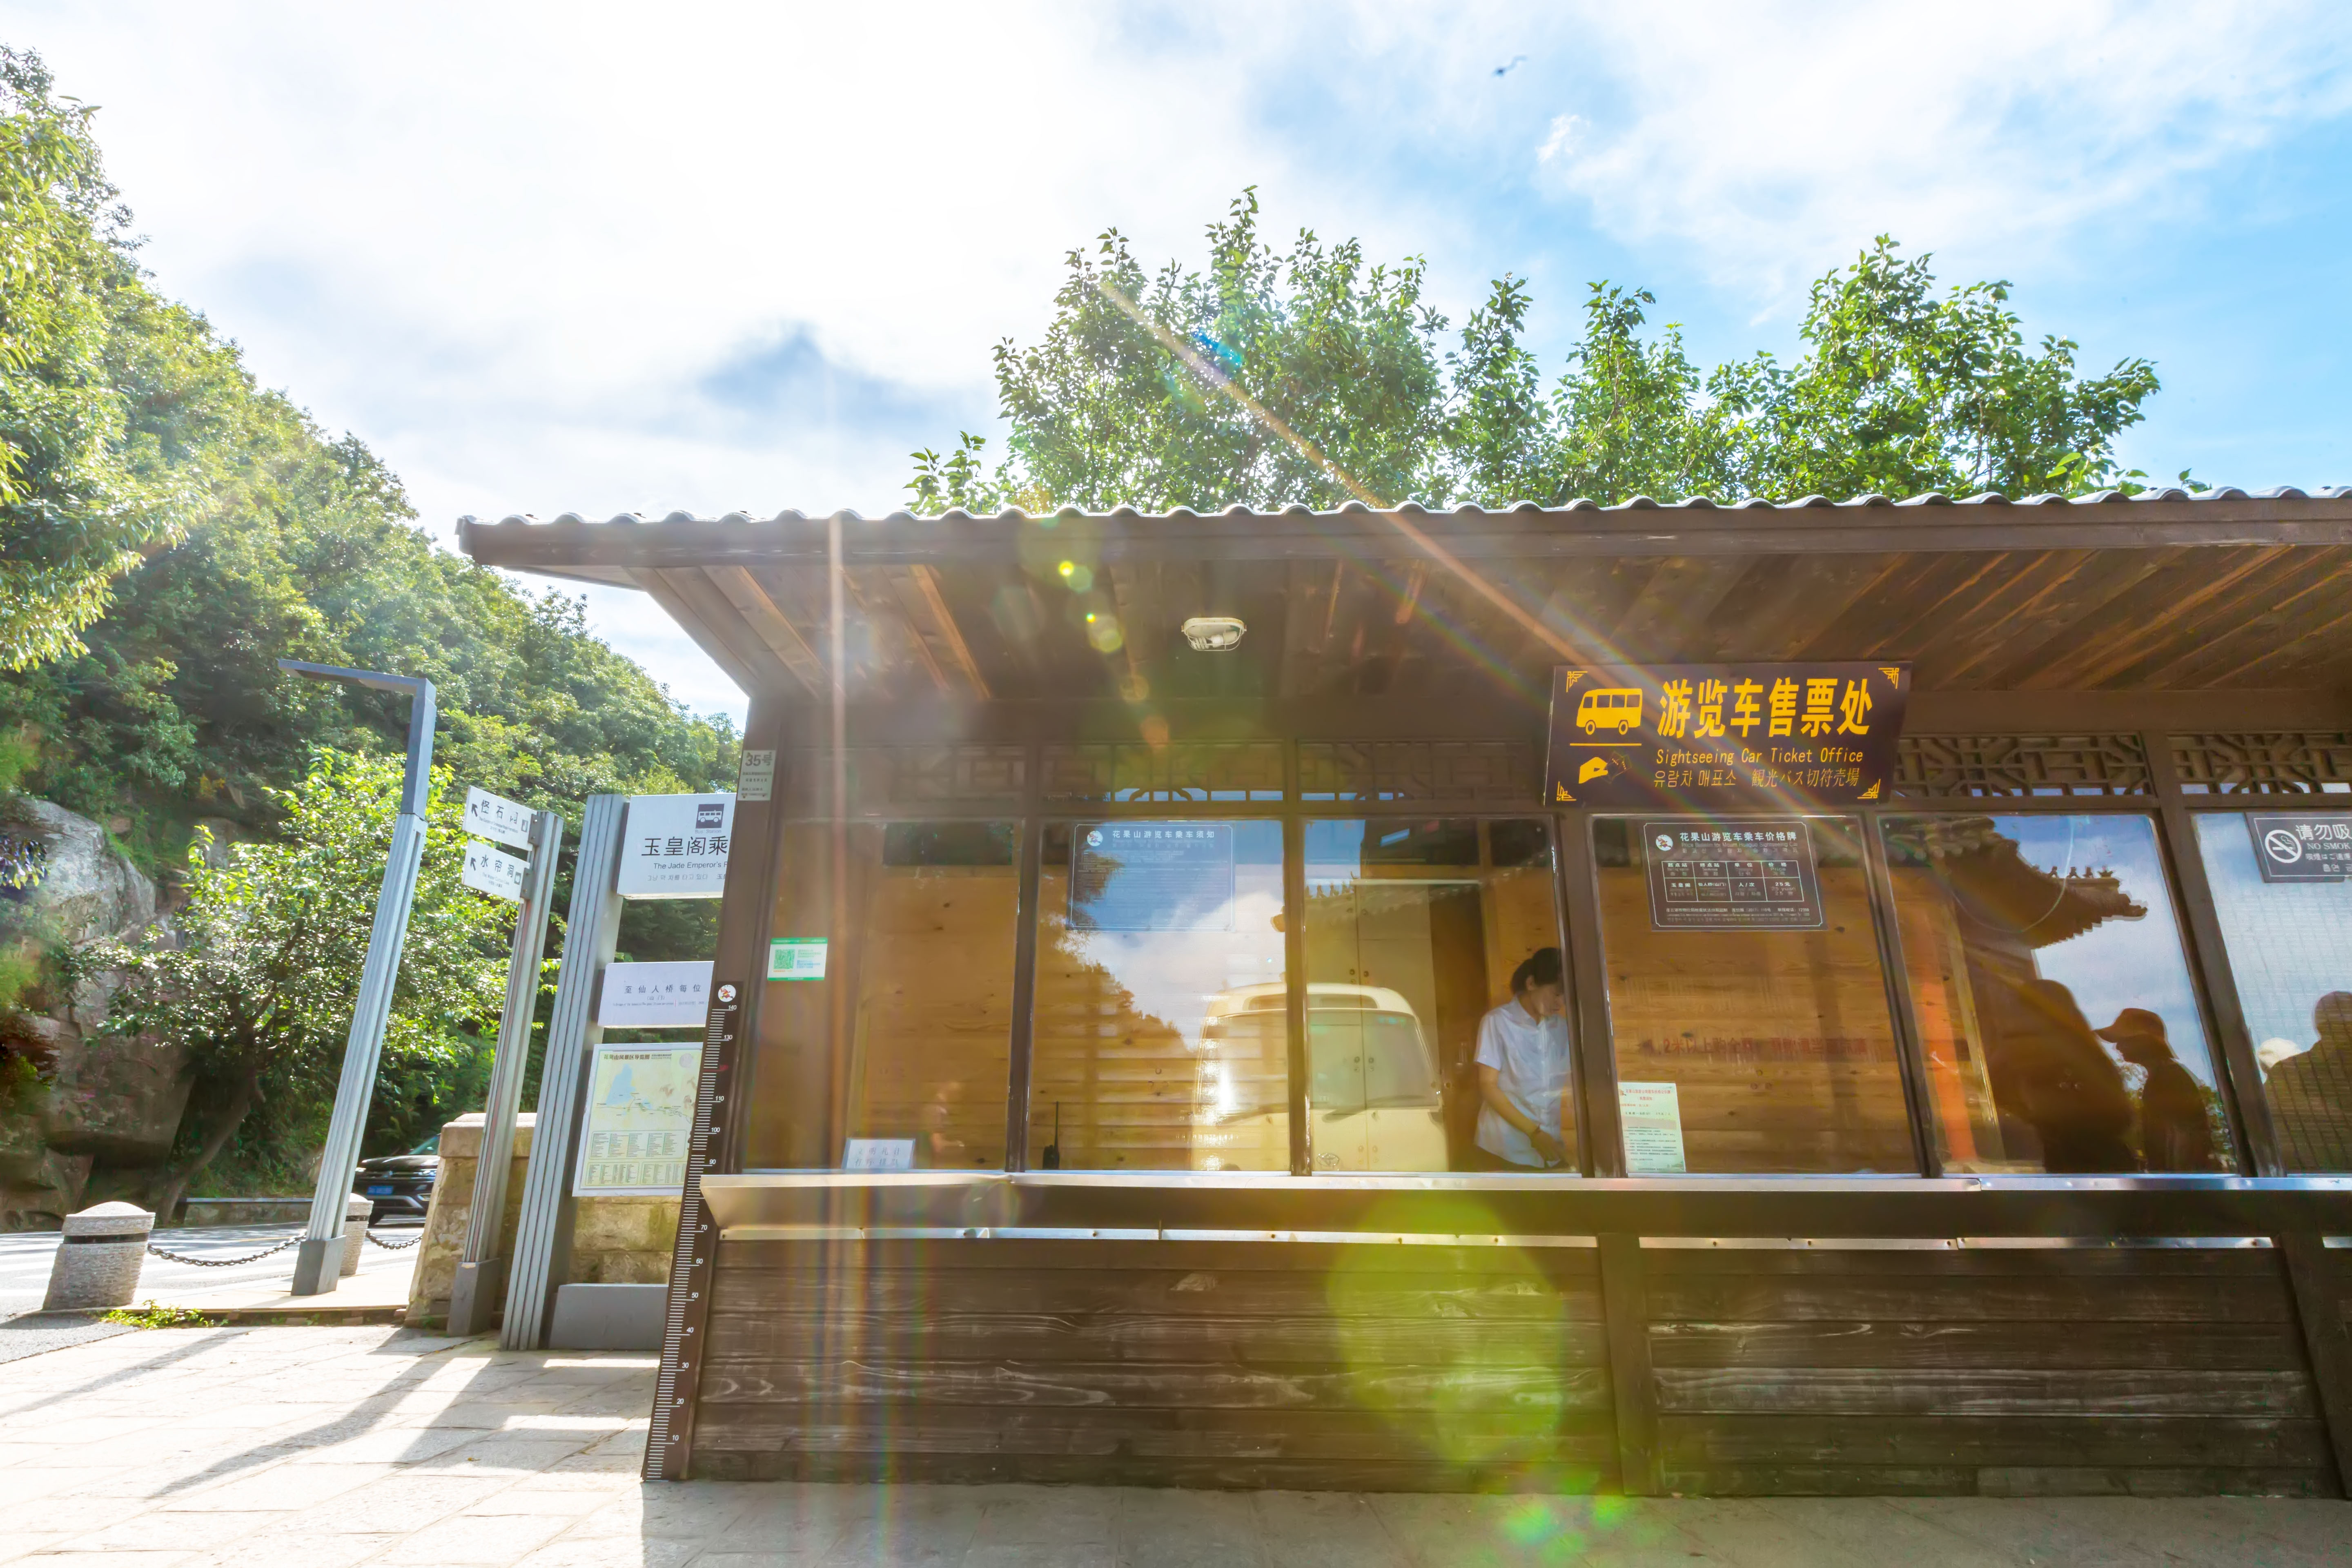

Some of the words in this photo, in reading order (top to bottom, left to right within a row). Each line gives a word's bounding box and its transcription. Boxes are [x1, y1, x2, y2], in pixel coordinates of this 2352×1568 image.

[1657, 677, 1873, 737] 游览车售票处
[745, 752, 773, 766] 35号
[1656, 748, 1735, 766] Sightseeing
[1742, 748, 1762, 763] Car
[1771, 747, 1812, 762] Ticket
[1820, 747, 1863, 762] Office
[1654, 770, 1692, 787] 유람차
[1698, 769, 1736, 787] 매표소
[1751, 768, 1860, 787] 観光バス切符売場
[1680, 832, 1797, 841] 花果山游览车乘车价格牌
[2296, 824, 2352, 840] 请勿吸
[641, 835, 728, 856] 玉皇阁乘
[481, 854, 514, 878] 水帘洞
[624, 984, 701, 993] 至仙人桥每位
